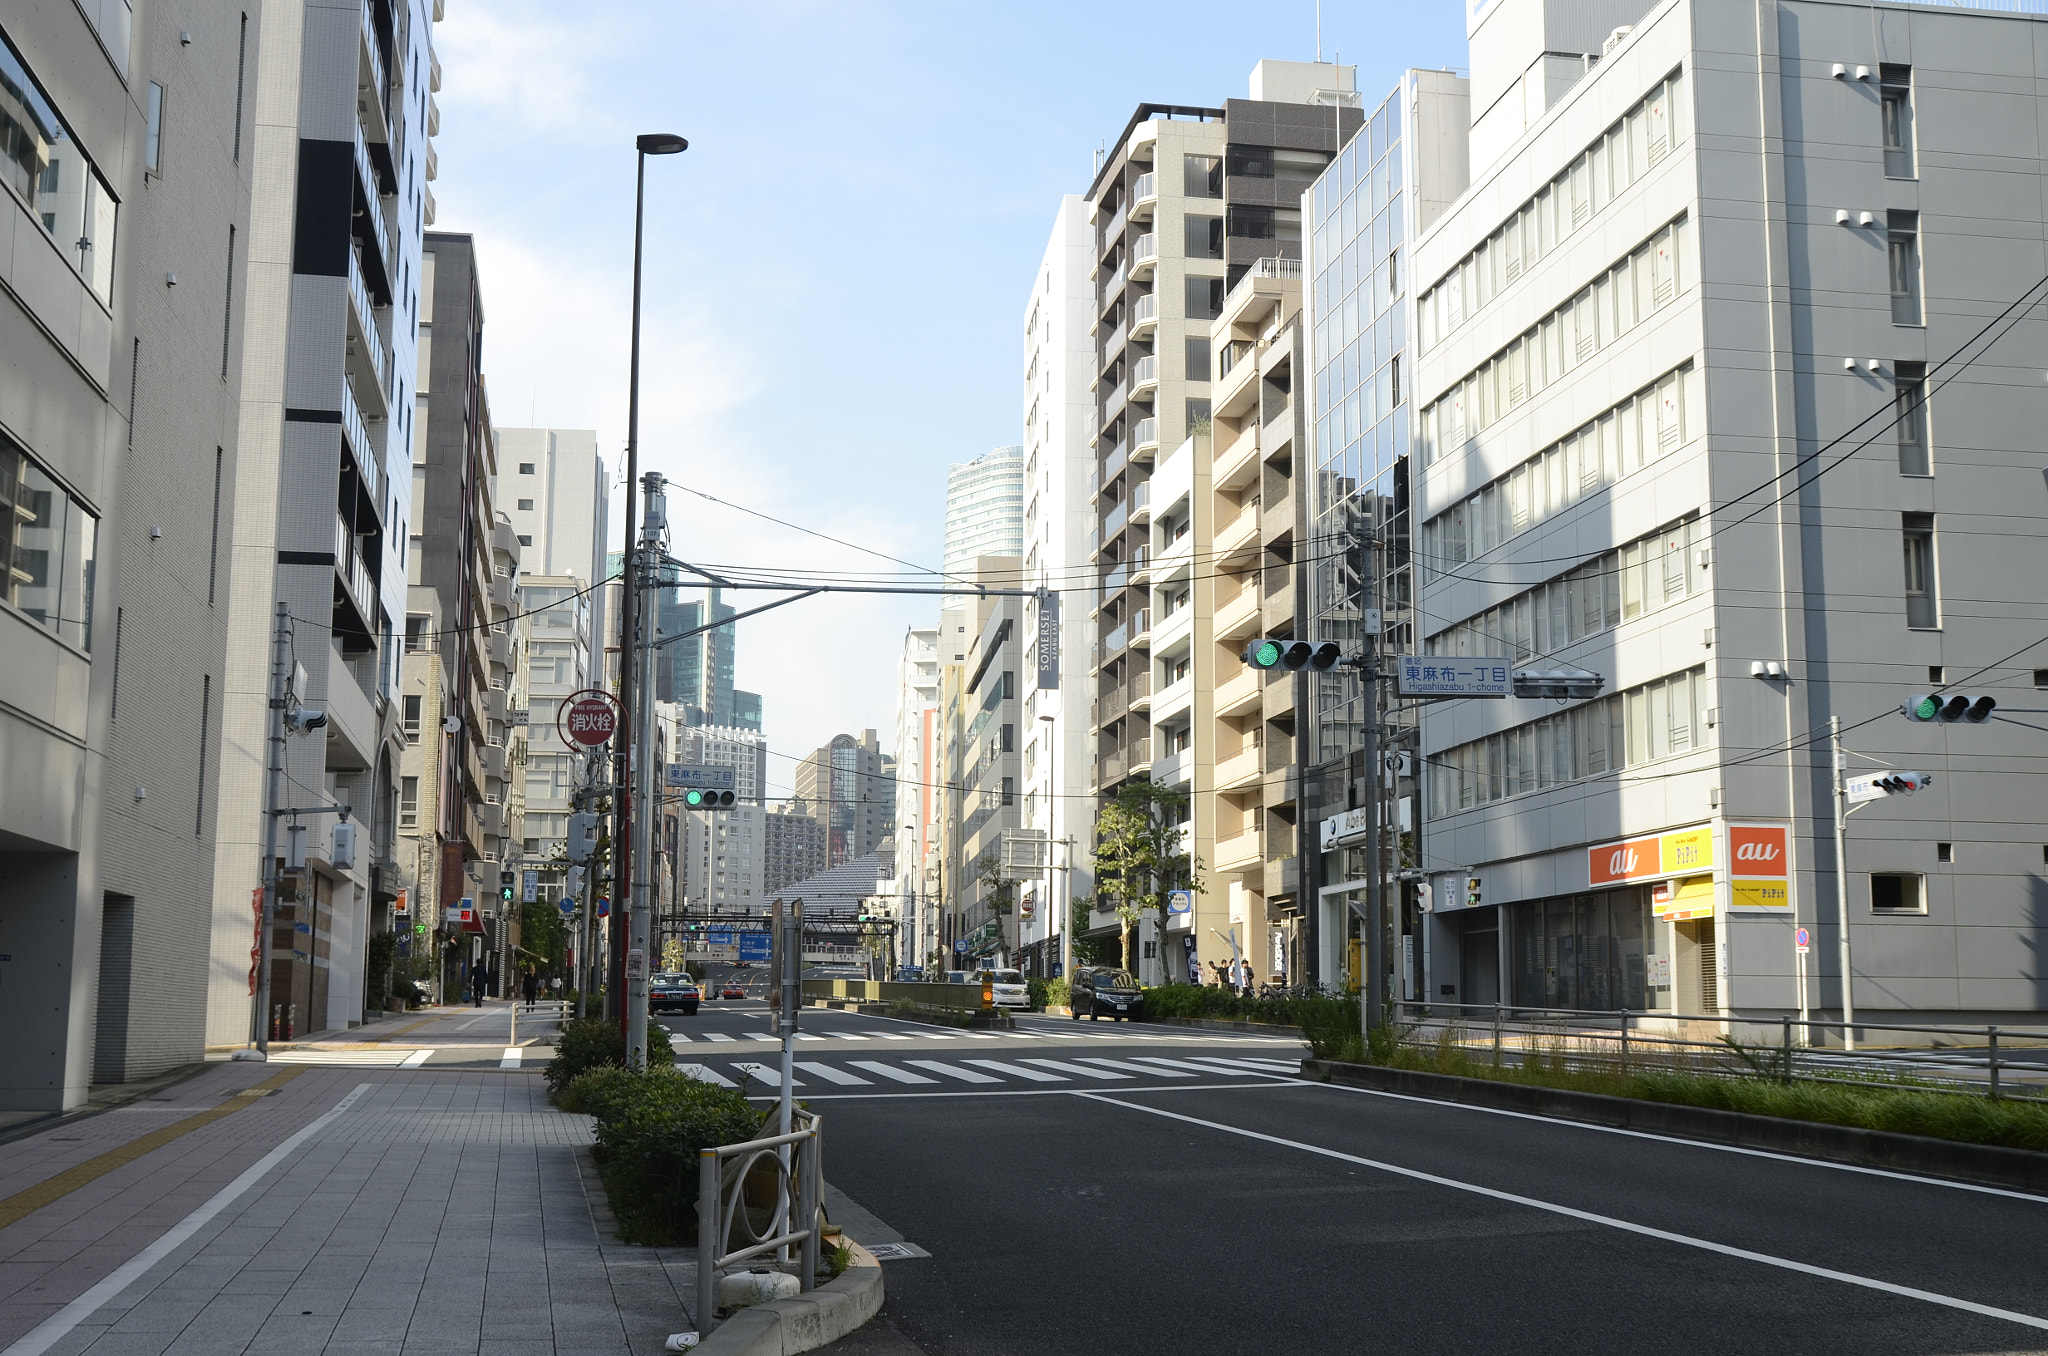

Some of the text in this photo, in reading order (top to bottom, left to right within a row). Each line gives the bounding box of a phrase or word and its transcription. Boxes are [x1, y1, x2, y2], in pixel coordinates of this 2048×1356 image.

[1040, 609, 1050, 671] SOMERSET
[1405, 657, 1421, 665] 港区
[1405, 666, 1506, 682] 東麻布一丁目
[1409, 682, 1504, 692] Higashiazabu 1-chome
[572, 713, 612, 731] 消火栓
[670, 770, 732, 781] 東麻布一丁目
[1676, 845, 1698, 865] PiPit
[1737, 842, 1780, 860] au
[1609, 848, 1638, 875] au
[1762, 888, 1785, 898] PiPit
[1274, 932, 1283, 971] ParkSIDER
